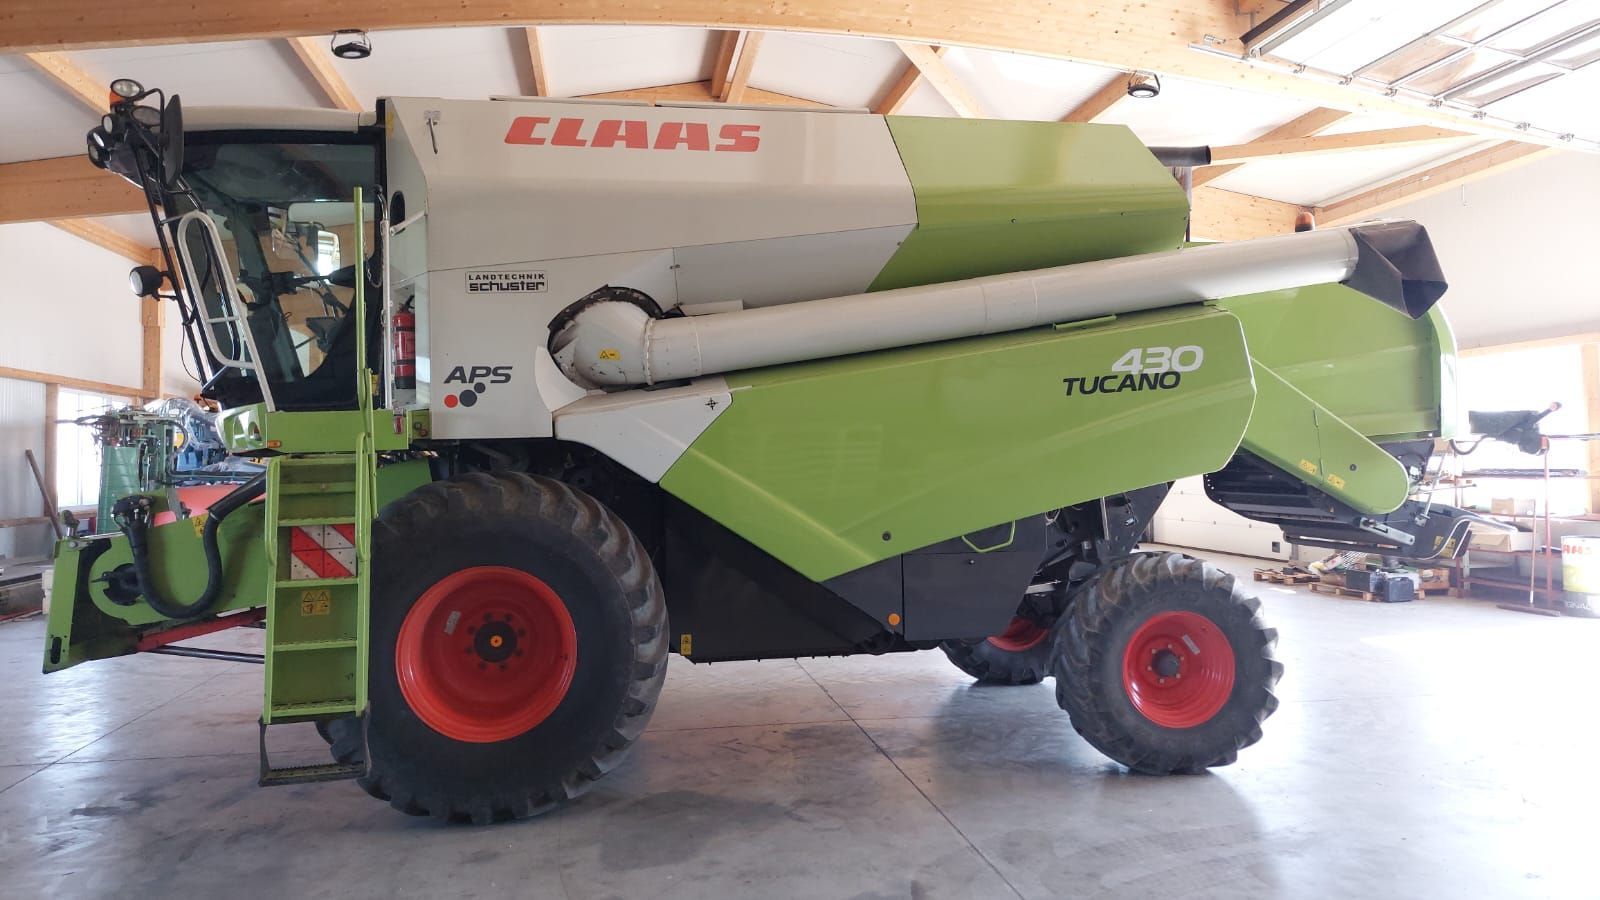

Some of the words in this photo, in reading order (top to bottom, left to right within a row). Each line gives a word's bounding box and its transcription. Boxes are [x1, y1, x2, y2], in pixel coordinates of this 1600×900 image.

[504, 116, 761, 152] CLAAS
[469, 281, 545, 291] schuster
[1111, 345, 1204, 375] 430
[443, 366, 513, 384] APS
[1063, 371, 1181, 396] TUCANO
